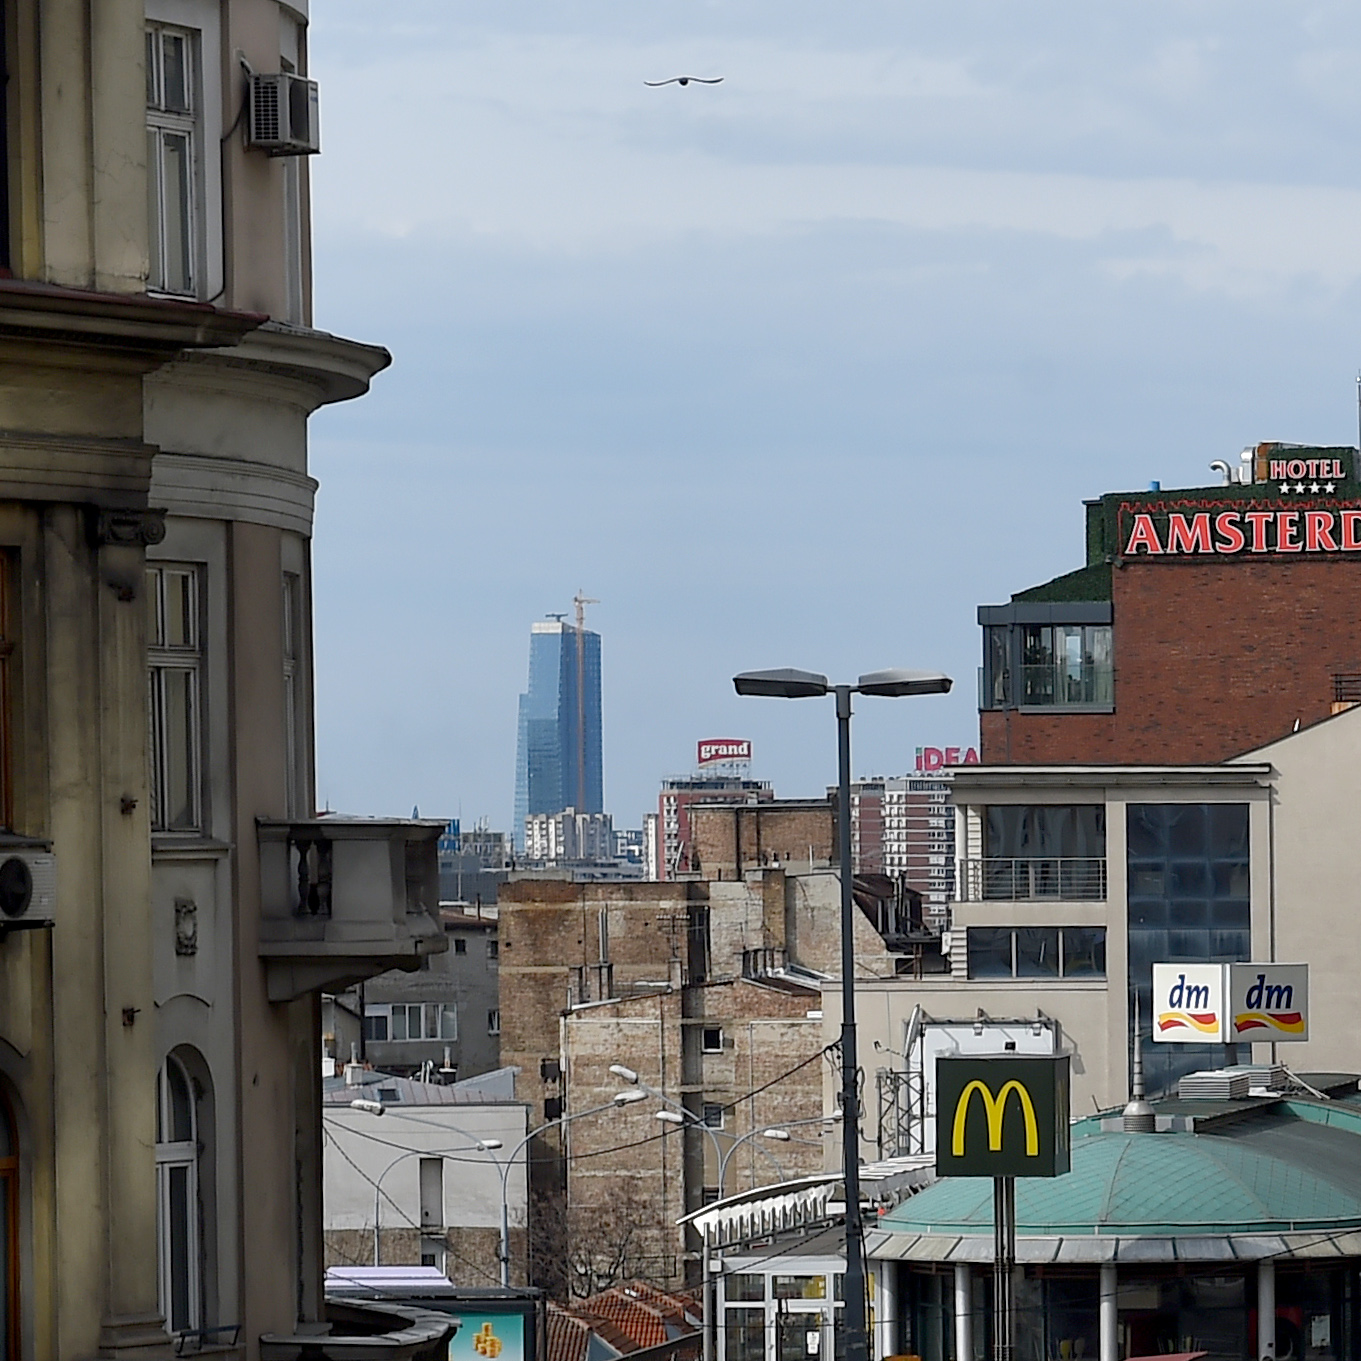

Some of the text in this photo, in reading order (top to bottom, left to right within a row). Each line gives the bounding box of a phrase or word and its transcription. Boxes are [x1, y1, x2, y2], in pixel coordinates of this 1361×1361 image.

[1269, 458, 1347, 480] HOTEL
[700, 742, 749, 759] grand
[1168, 974, 1209, 1010] dm
[1245, 974, 1293, 1010] dm
